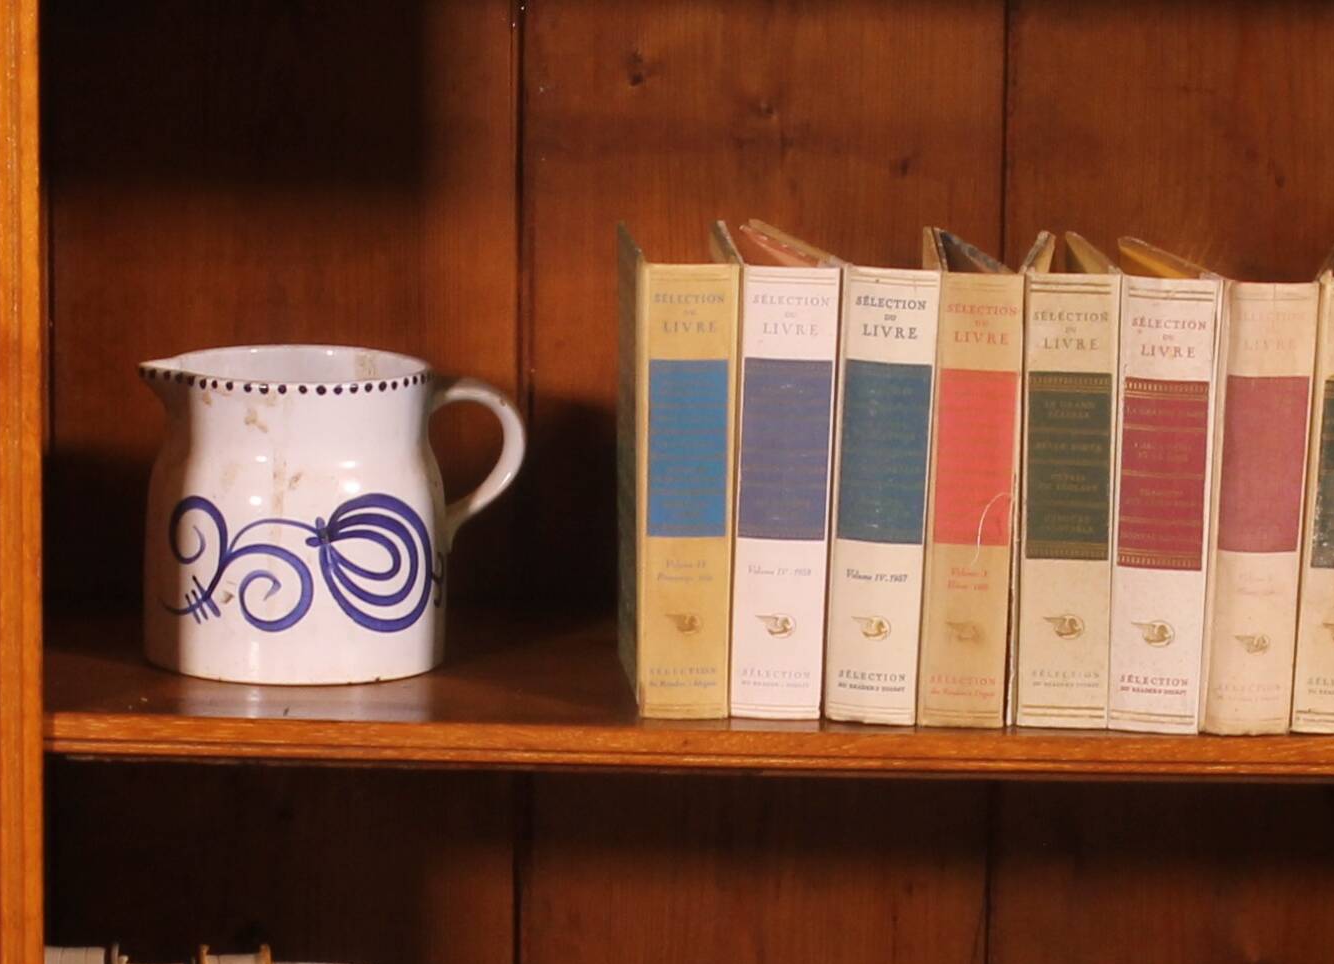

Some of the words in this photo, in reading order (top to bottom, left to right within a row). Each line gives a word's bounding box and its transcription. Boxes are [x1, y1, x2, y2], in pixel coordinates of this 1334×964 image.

[752, 293, 831, 307] SÉLECTION
[855, 294, 927, 311] SÉLECTION
[1033, 309, 1109, 322] SÉLECTION
[662, 320, 717, 335] LIVRE
[762, 322, 820, 337] LIVRE
[1131, 316, 1208, 332] SÉLECTION
[861, 323, 919, 340] LIVRE
[954, 330, 1009, 346] LIVRE
[1044, 338, 1100, 352] LIVRE
[1140, 344, 1196, 359] LIVRE
[846, 568, 873, 581] Volume
[741, 666, 811, 680] SÉLECTION
[838, 669, 906, 682] SÉLECTION
[1120, 674, 1188, 687] SÉLECTION
